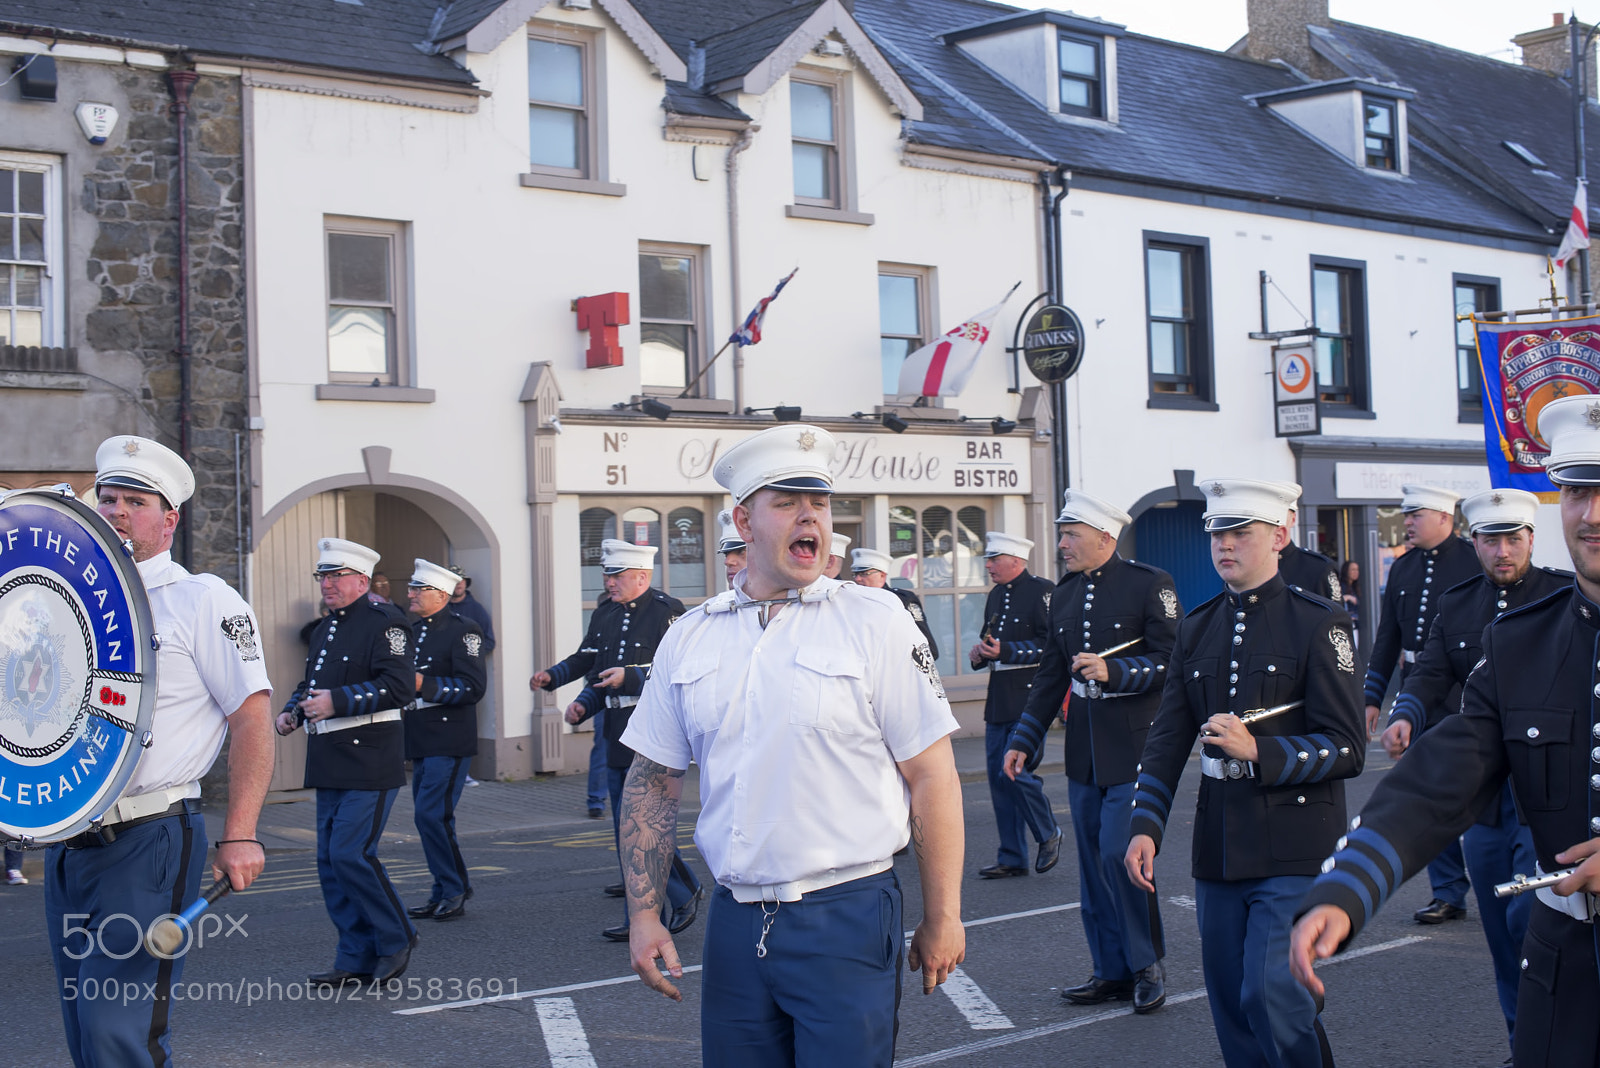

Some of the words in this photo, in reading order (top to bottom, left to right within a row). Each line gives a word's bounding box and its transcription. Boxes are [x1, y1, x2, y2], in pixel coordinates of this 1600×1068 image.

[1025, 330, 1076, 349] GUINNESS
[1561, 343, 1584, 356] BOYS
[1519, 364, 1566, 388] BROWNING
[1571, 366, 1599, 385] CLUB
[829, 436, 940, 481] House
[966, 441, 1002, 459] BAR
[606, 465, 627, 485] 51
[954, 469, 1018, 487] BISTRO
[30, 527, 80, 566] THE
[82, 562, 122, 662] BANN
